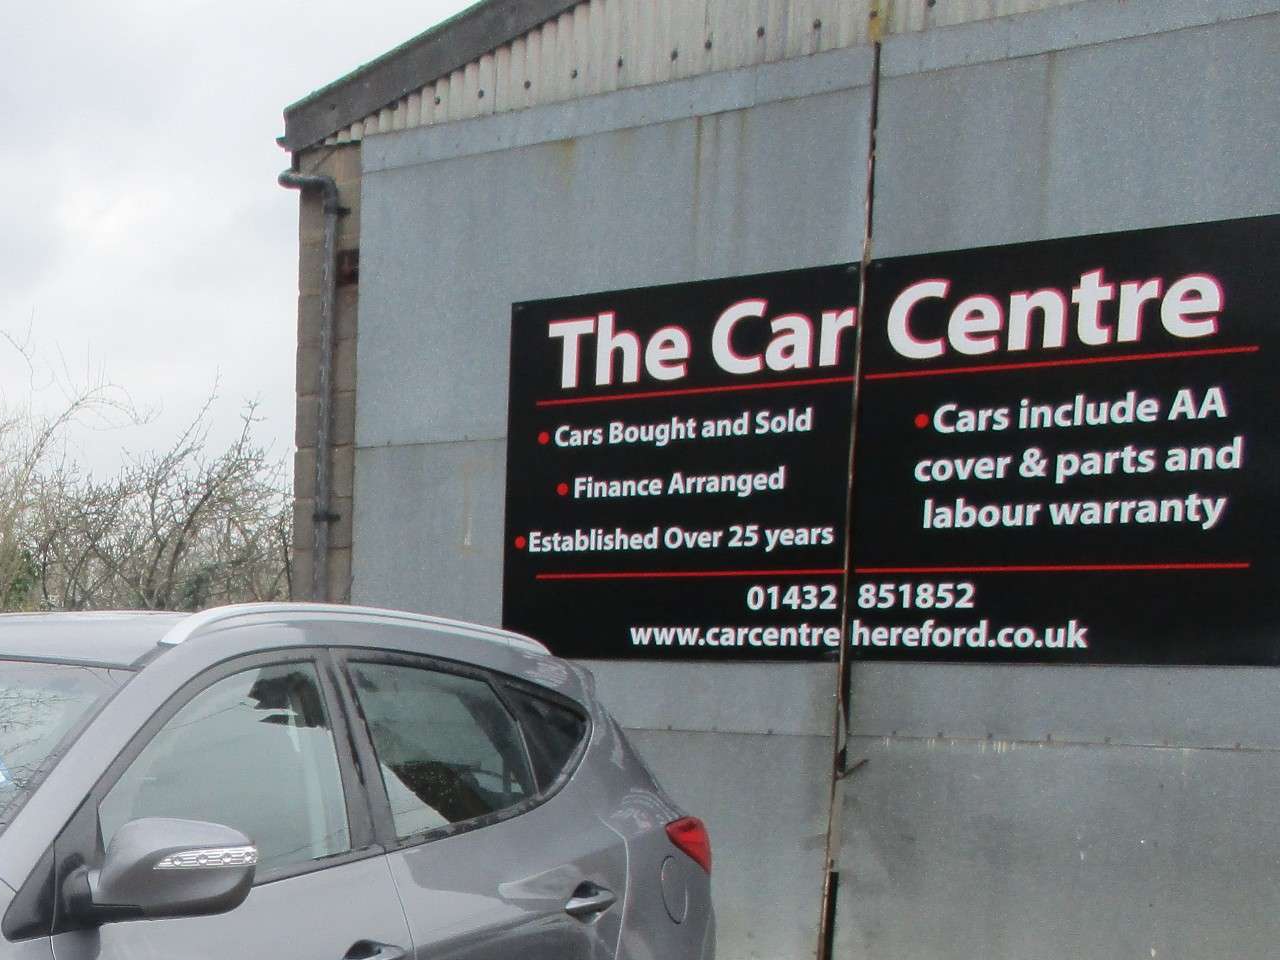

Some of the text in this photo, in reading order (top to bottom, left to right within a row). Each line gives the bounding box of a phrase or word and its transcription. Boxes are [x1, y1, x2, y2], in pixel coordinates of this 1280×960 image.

[548, 268, 1224, 389] The Car Centre
[554, 407, 813, 447] Cars Bought and Sold
[933, 387, 1228, 433] Cars include AA
[913, 436, 1244, 485] cover & parts and
[573, 465, 786, 498] Finance Arranged
[922, 493, 1228, 530] labour warranty
[528, 525, 835, 553] Established Over 25 years
[746, 582, 976, 611] 01432 851852
